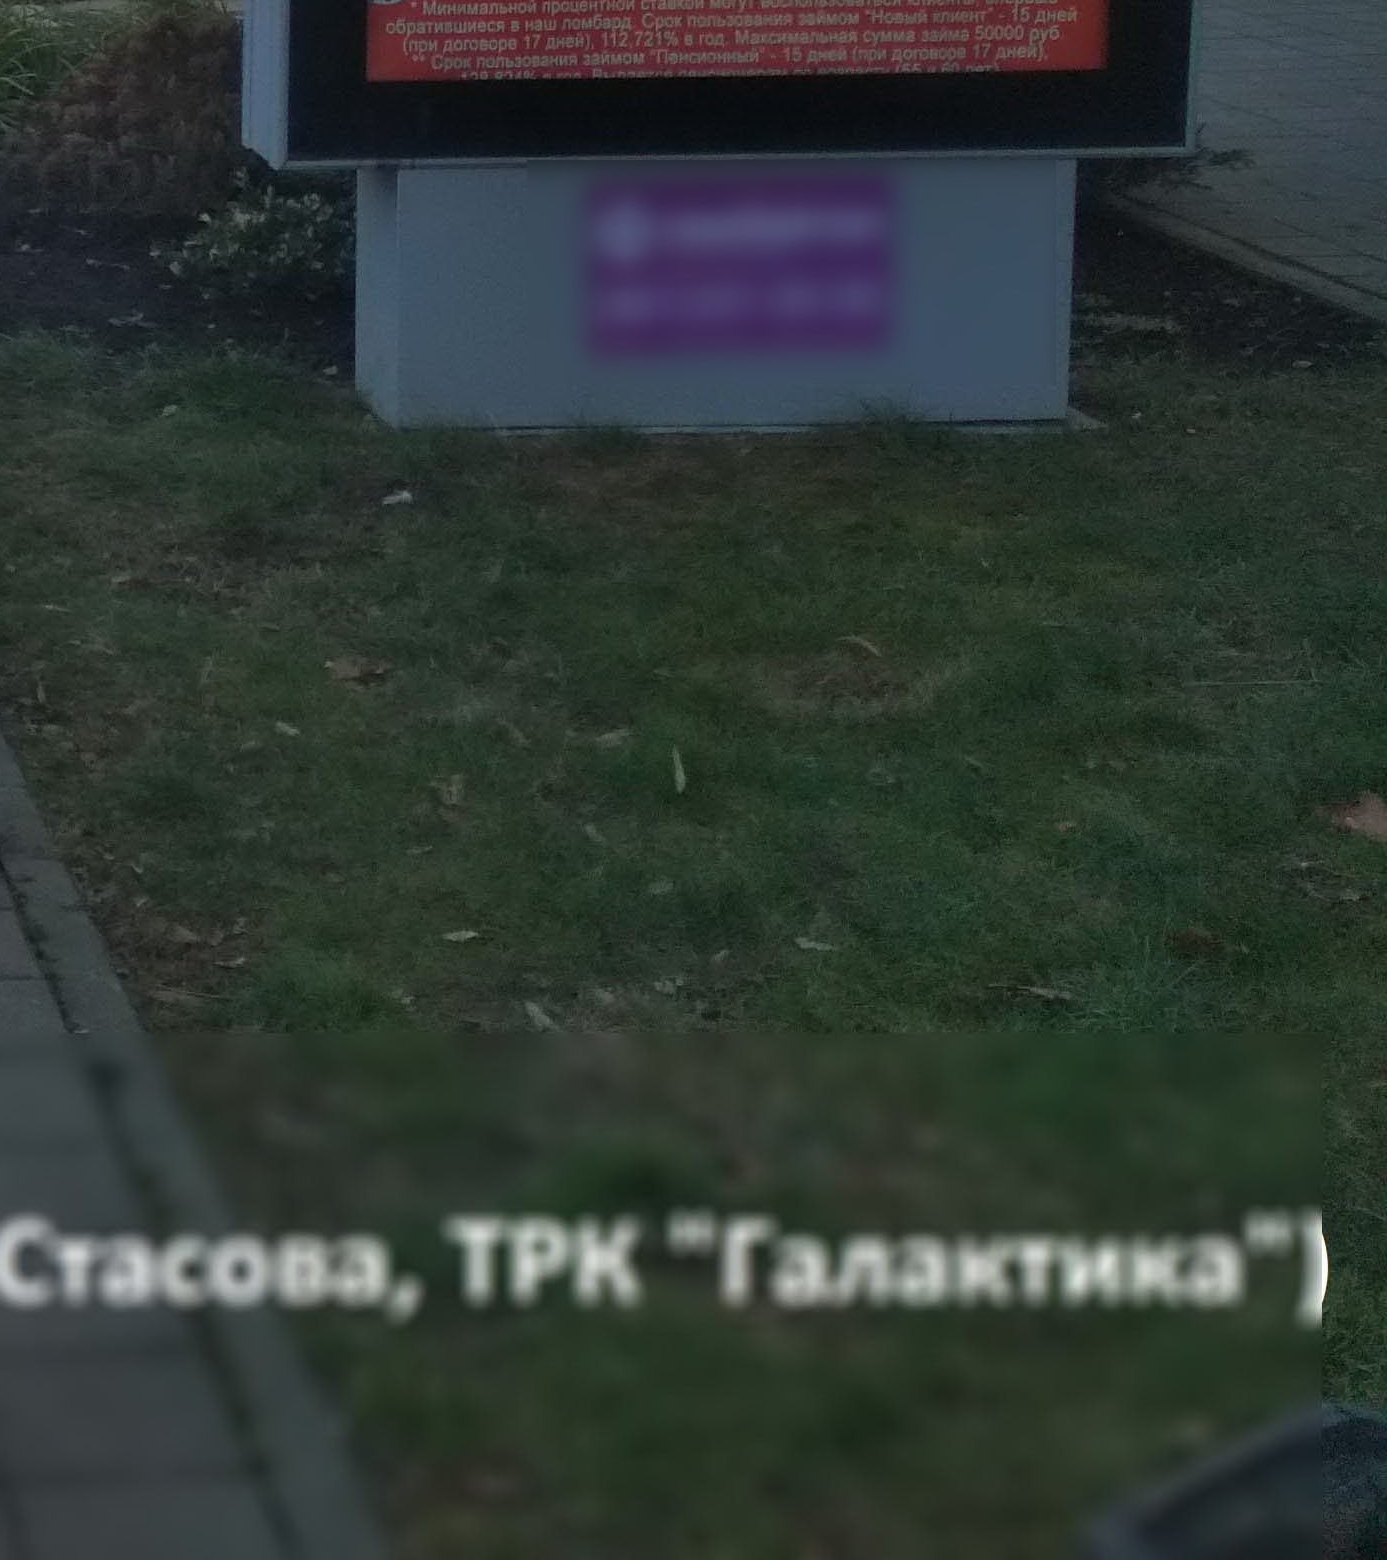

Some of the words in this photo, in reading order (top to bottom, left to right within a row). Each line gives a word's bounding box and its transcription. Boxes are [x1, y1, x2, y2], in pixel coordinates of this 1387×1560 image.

[386, 18, 505, 36] обратившиеся
[510, 20, 519, 32] в
[524, 20, 556, 32] наш
[642, 13, 682, 32] Срок
[687, 15, 793, 29] пользования
[798, 11, 859, 27] займом
[1012, 7, 1029, 23] 15
[1035, 7, 1078, 25] дней
[423, 0, 536, 15] Минимальной
[403, 37, 437, 55] (при
[443, 38, 517, 53] договоре
[524, 34, 539, 49] 17
[735, 28, 857, 45] Максимальная
[863, 31, 915, 47] сумма
[921, 27, 969, 42] займа
[975, 25, 1024, 41] 50000
[431, 55, 471, 73] Срок
[476, 55, 577, 69] пользования
[583, 51, 645, 66] займом
[785, 47, 802, 63] 15
[807, 47, 847, 65] дней
[852, 47, 886, 65] (при
[891, 48, 966, 64] договоре
[973, 44, 990, 59] 17
